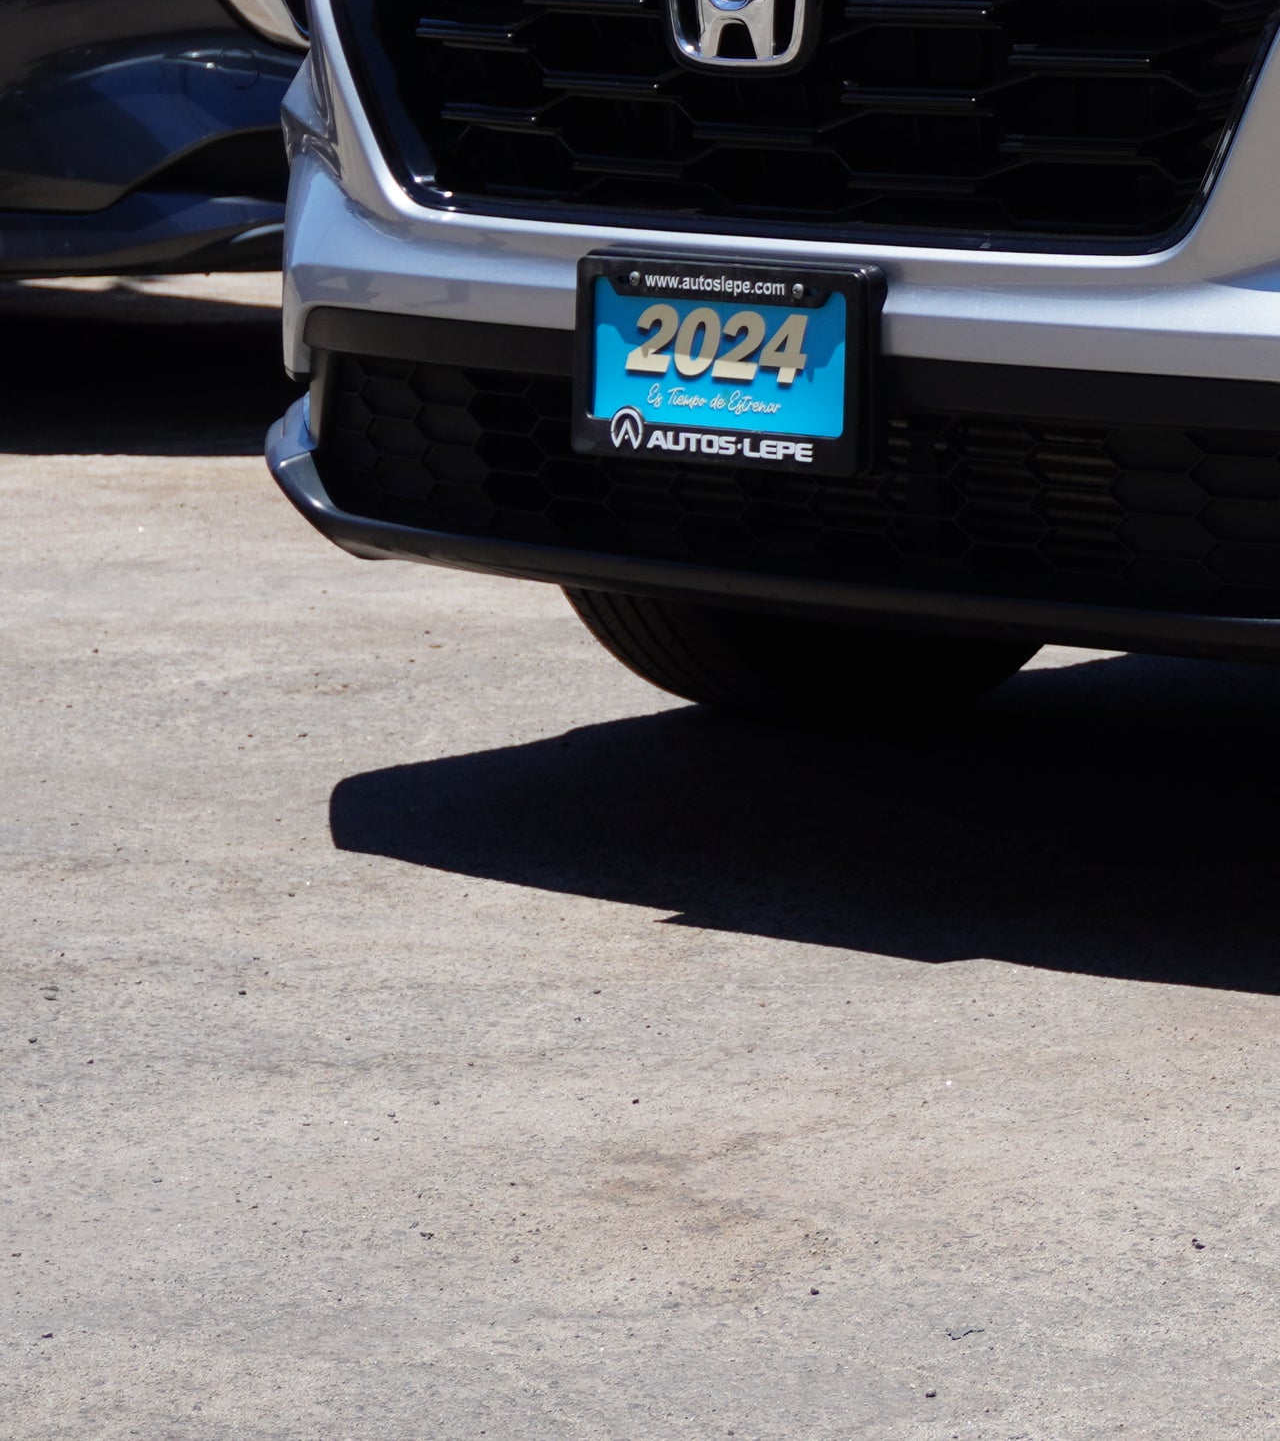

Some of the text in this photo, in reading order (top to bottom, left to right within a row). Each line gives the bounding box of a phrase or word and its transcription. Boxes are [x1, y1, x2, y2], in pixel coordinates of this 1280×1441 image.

[645, 273, 786, 297] www.autoslepe.com
[625, 303, 809, 384] 2024
[647, 383, 782, 415] Es Tiempo de Estrenar
